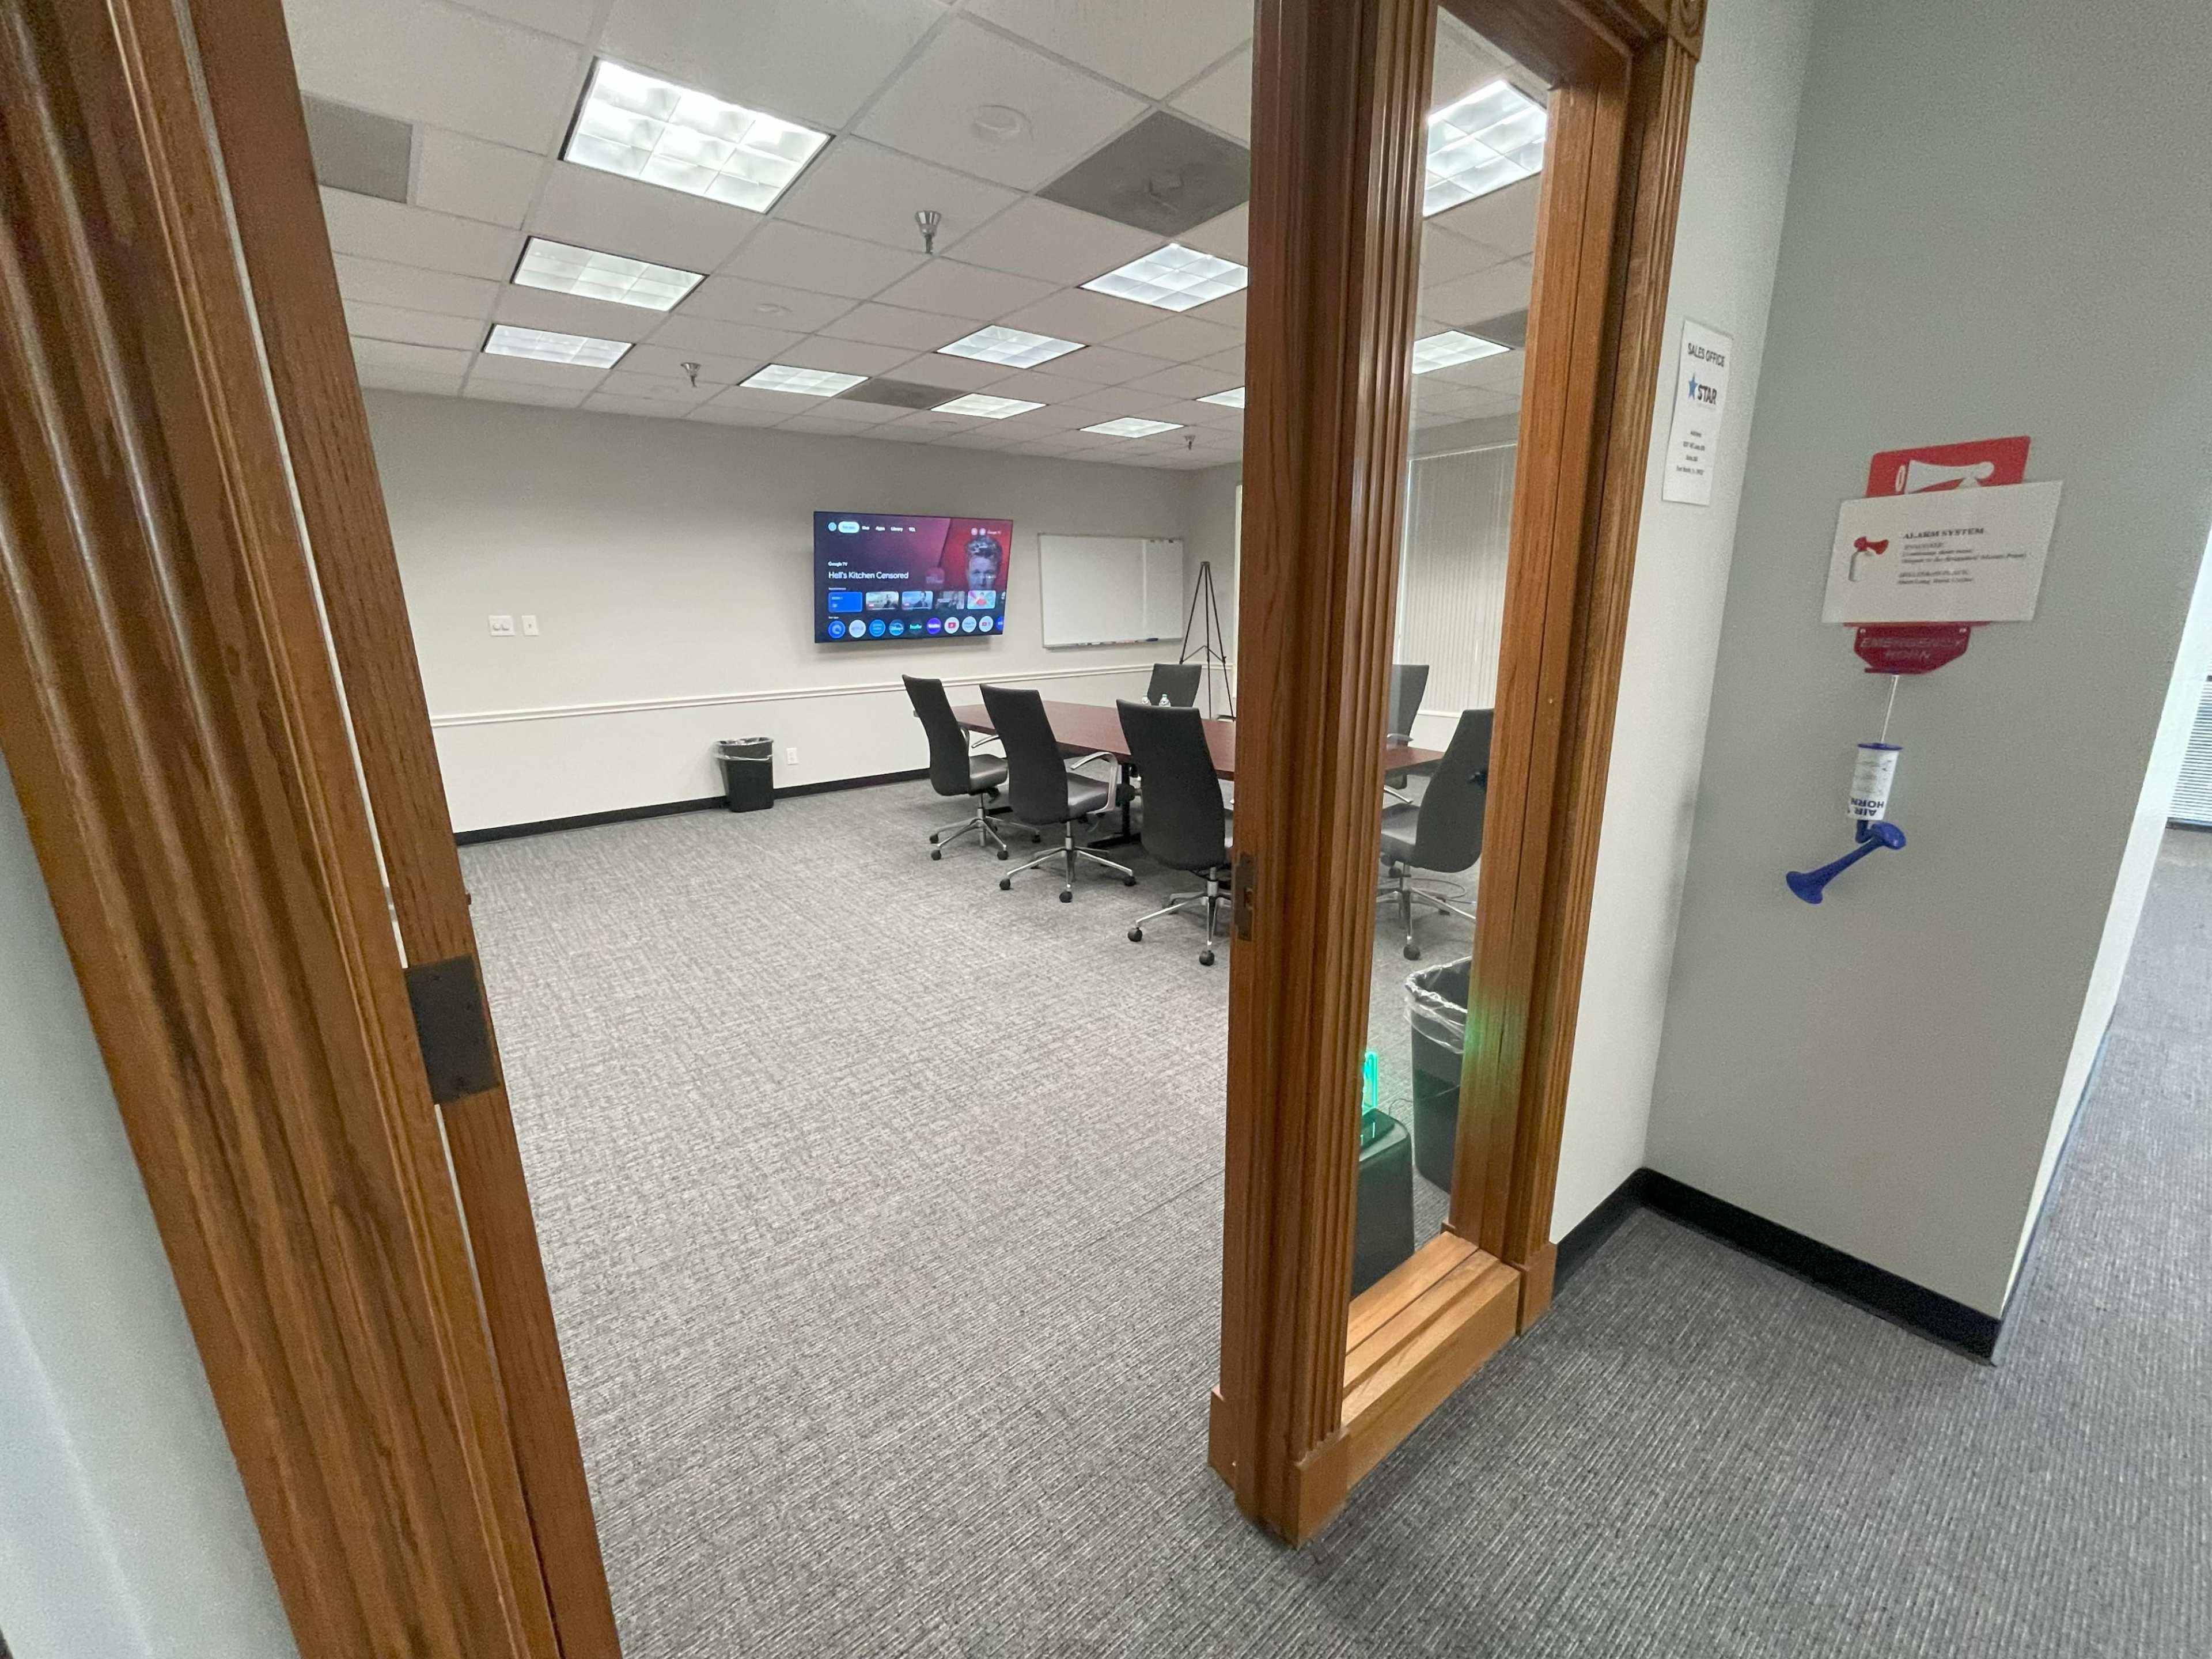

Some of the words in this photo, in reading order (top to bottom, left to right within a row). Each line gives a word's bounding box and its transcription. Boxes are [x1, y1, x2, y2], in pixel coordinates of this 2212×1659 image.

[1688, 343, 1705, 360] SALES
[1705, 350, 1725, 368] OFFICE
[1697, 384, 1717, 405] STAR
[1902, 530, 1939, 539] ALARM
[1941, 527, 1984, 536] SYSTEM
[828, 571, 847, 579] Hell's
[848, 571, 875, 579] Kitchen
[876, 571, 909, 579] Censored
[1850, 797, 1884, 808] HORN
[1854, 807, 1877, 816] AIR
